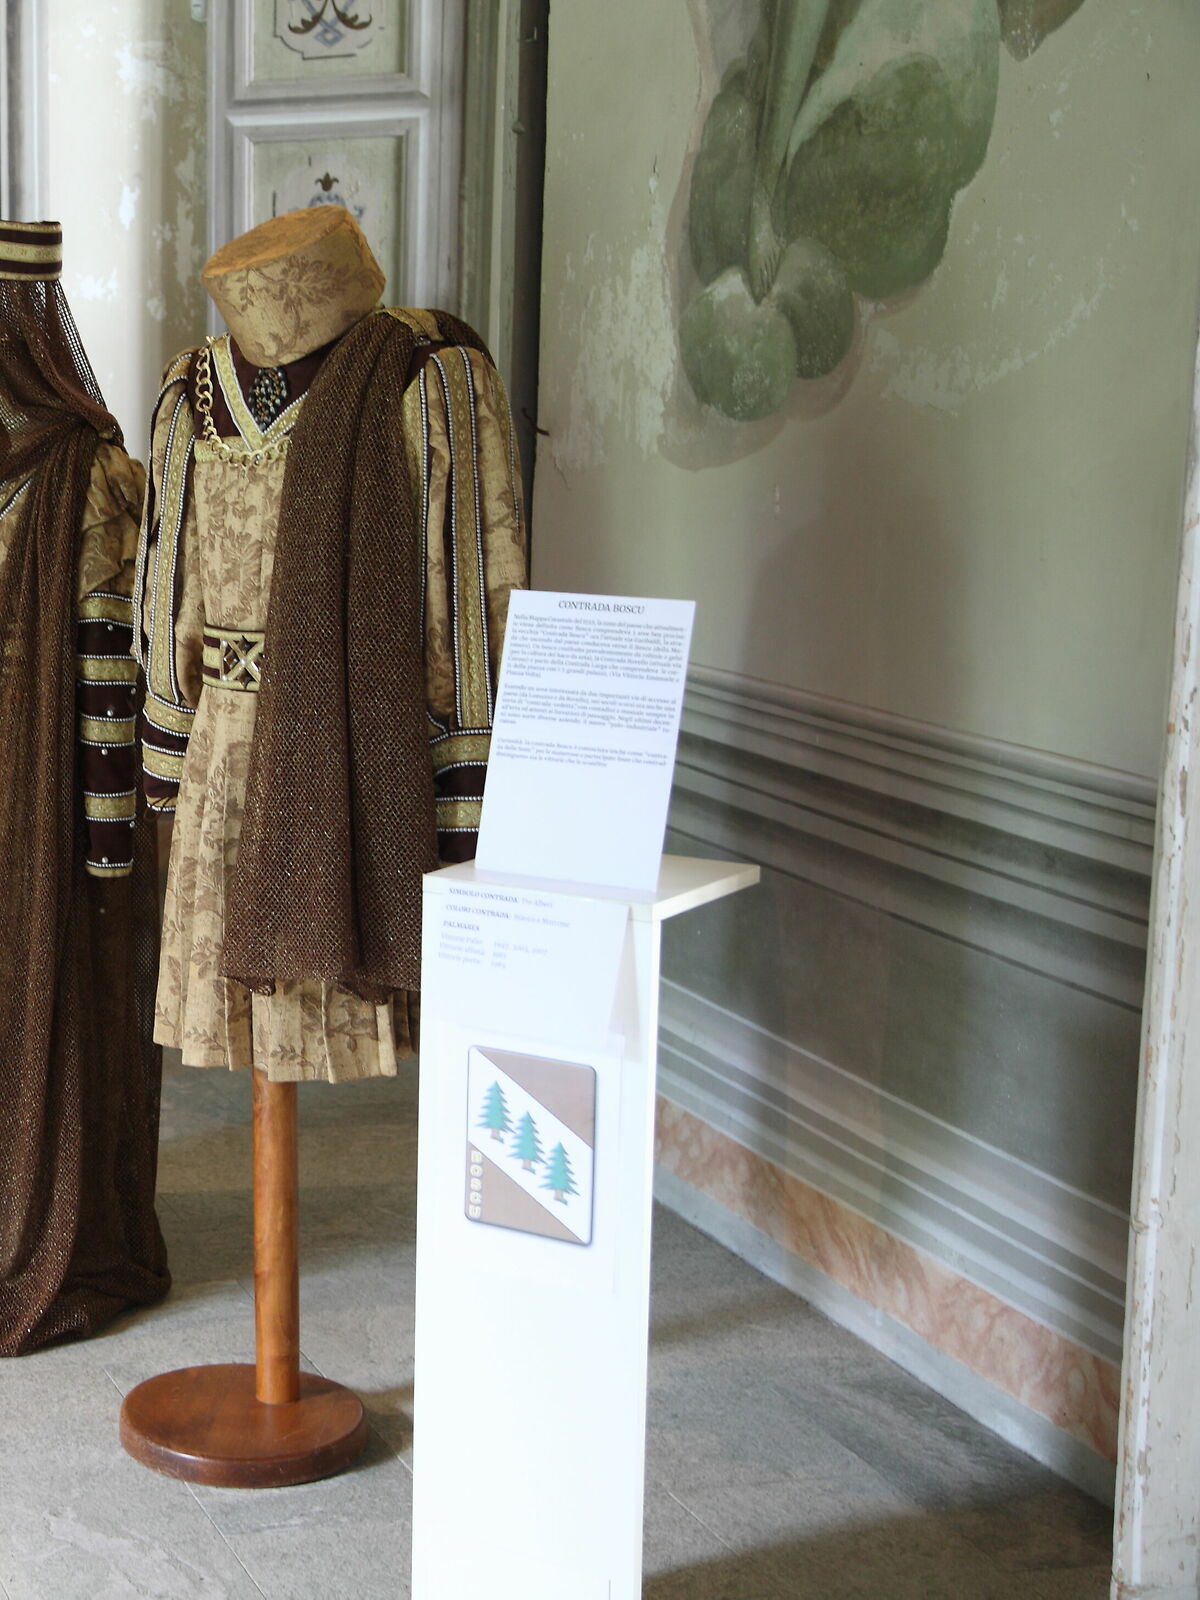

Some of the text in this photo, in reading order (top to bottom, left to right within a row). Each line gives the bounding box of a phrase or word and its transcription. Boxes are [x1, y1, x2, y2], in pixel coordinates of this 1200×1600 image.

[558, 600, 645, 615] CONTRADA BOSCU
[468, 1150, 483, 1217] BOSCU
